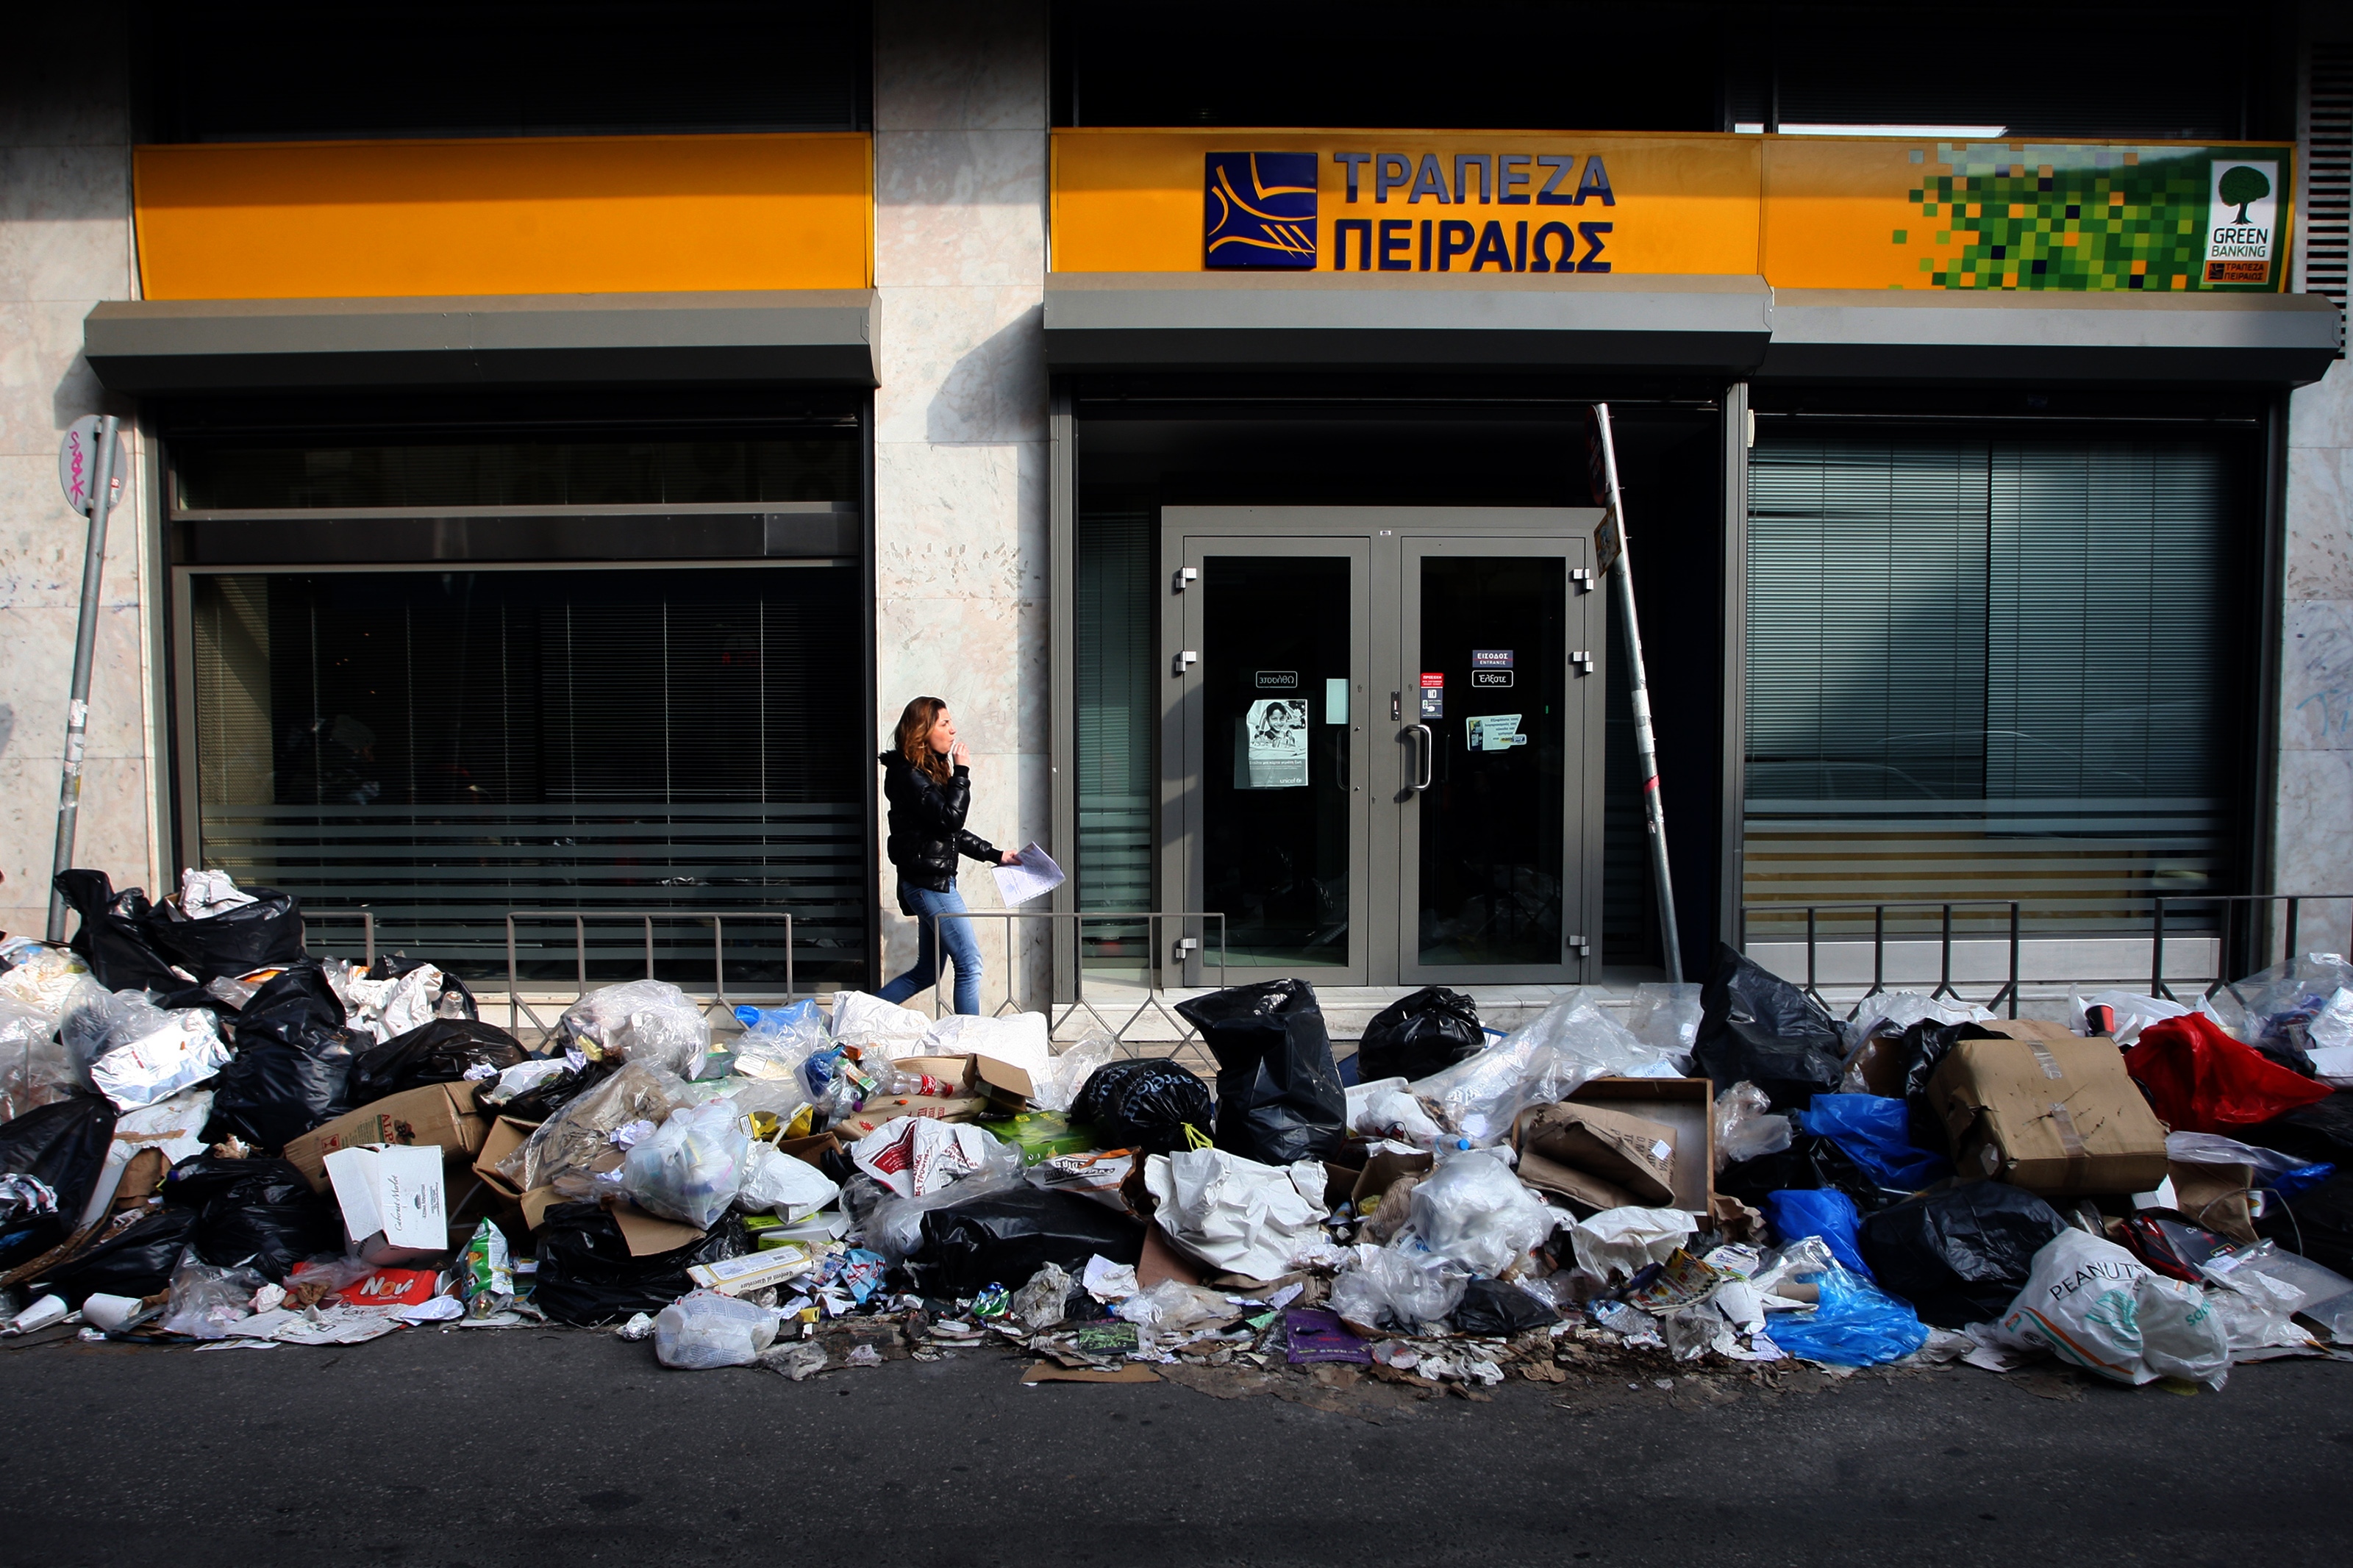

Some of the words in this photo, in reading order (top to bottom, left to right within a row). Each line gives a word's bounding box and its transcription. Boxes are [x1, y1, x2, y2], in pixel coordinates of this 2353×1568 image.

[1334, 152, 1616, 207] ΤΡΑΠΕΖΑ
[1335, 219, 1614, 273] ΠΕΙΡΑΙΩΣ
[2213, 228, 2268, 244] GREEN
[2211, 245, 2266, 257] BANKING
[2224, 272, 2263, 280] ΠΕΙΡΑΙΩΣ
[2226, 263, 2264, 271] ΤΡΑΠΕΖΑ
[382, 1114, 396, 1144] ALP
[2049, 1261, 2144, 1301] PEANUTS
